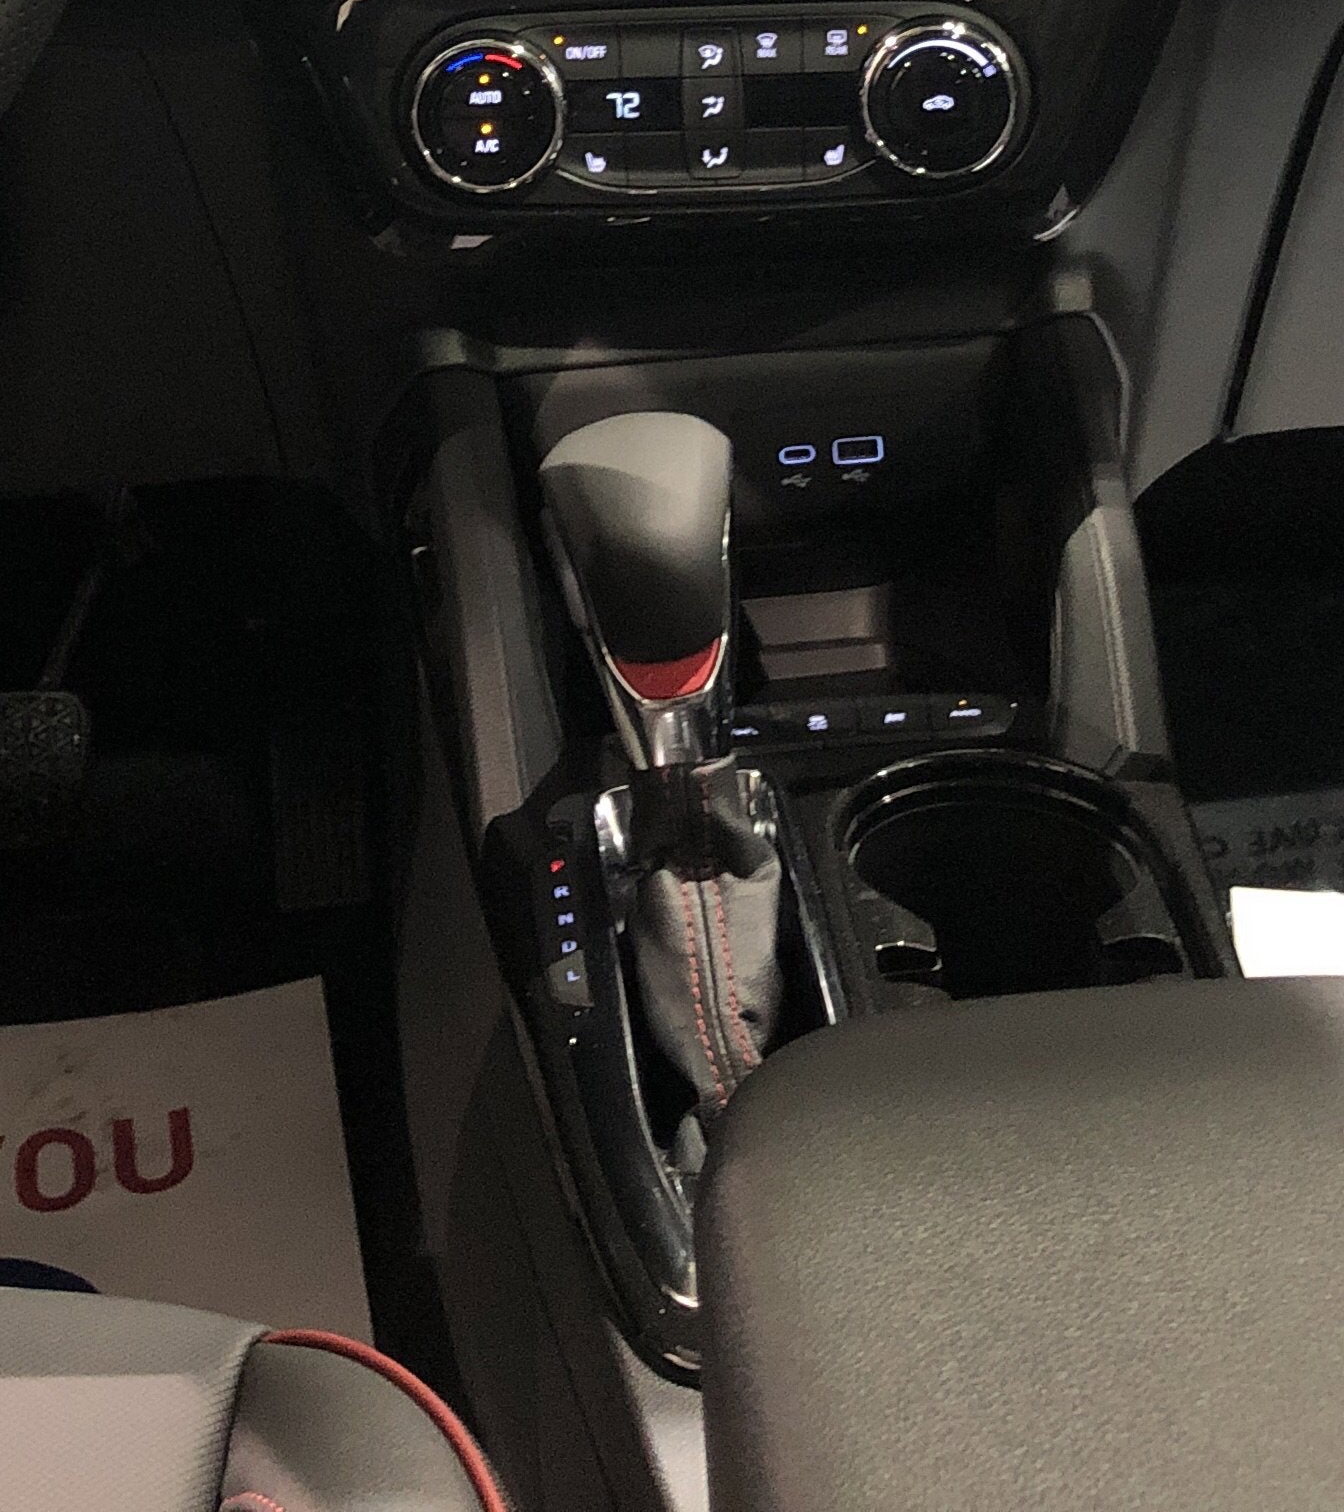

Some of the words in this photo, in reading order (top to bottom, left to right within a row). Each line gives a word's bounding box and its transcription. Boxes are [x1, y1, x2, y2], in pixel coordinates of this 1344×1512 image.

[565, 45, 607, 60] ON/OFF
[468, 90, 502, 105] AUTO
[606, 92, 640, 119] 72
[474, 139, 500, 153] A/C
[553, 885, 571, 898] R
[557, 912, 574, 926] N
[561, 940, 578, 953] D
